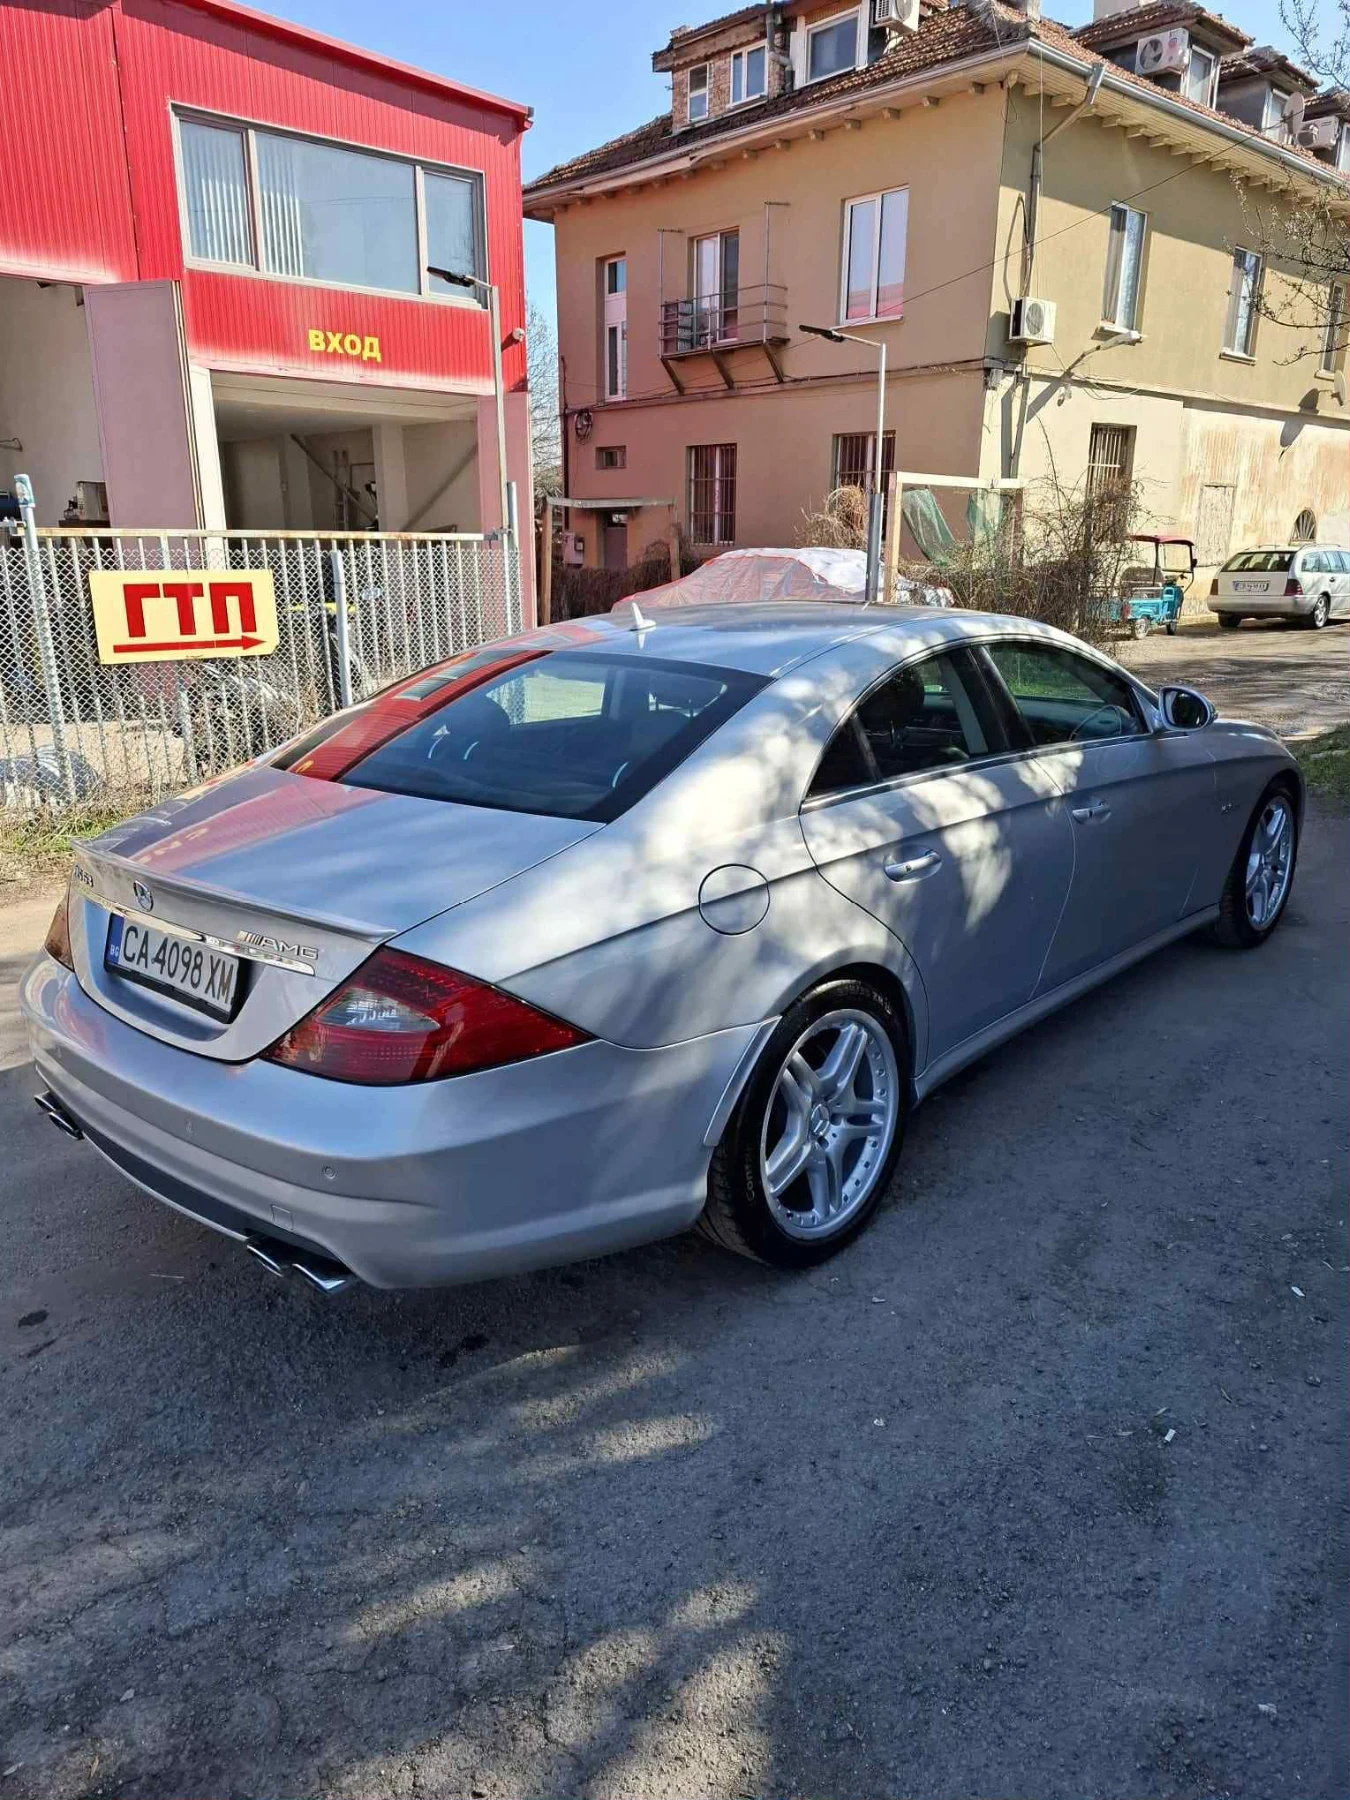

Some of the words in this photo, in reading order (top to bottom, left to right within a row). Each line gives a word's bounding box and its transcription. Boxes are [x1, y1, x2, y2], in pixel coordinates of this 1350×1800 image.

[308, 328, 382, 363] ВХОД
[123, 582, 257, 637] ГТП
[109, 944, 120, 957] BG
[151, 937, 204, 989] 4098
[204, 954, 234, 1004] XM
